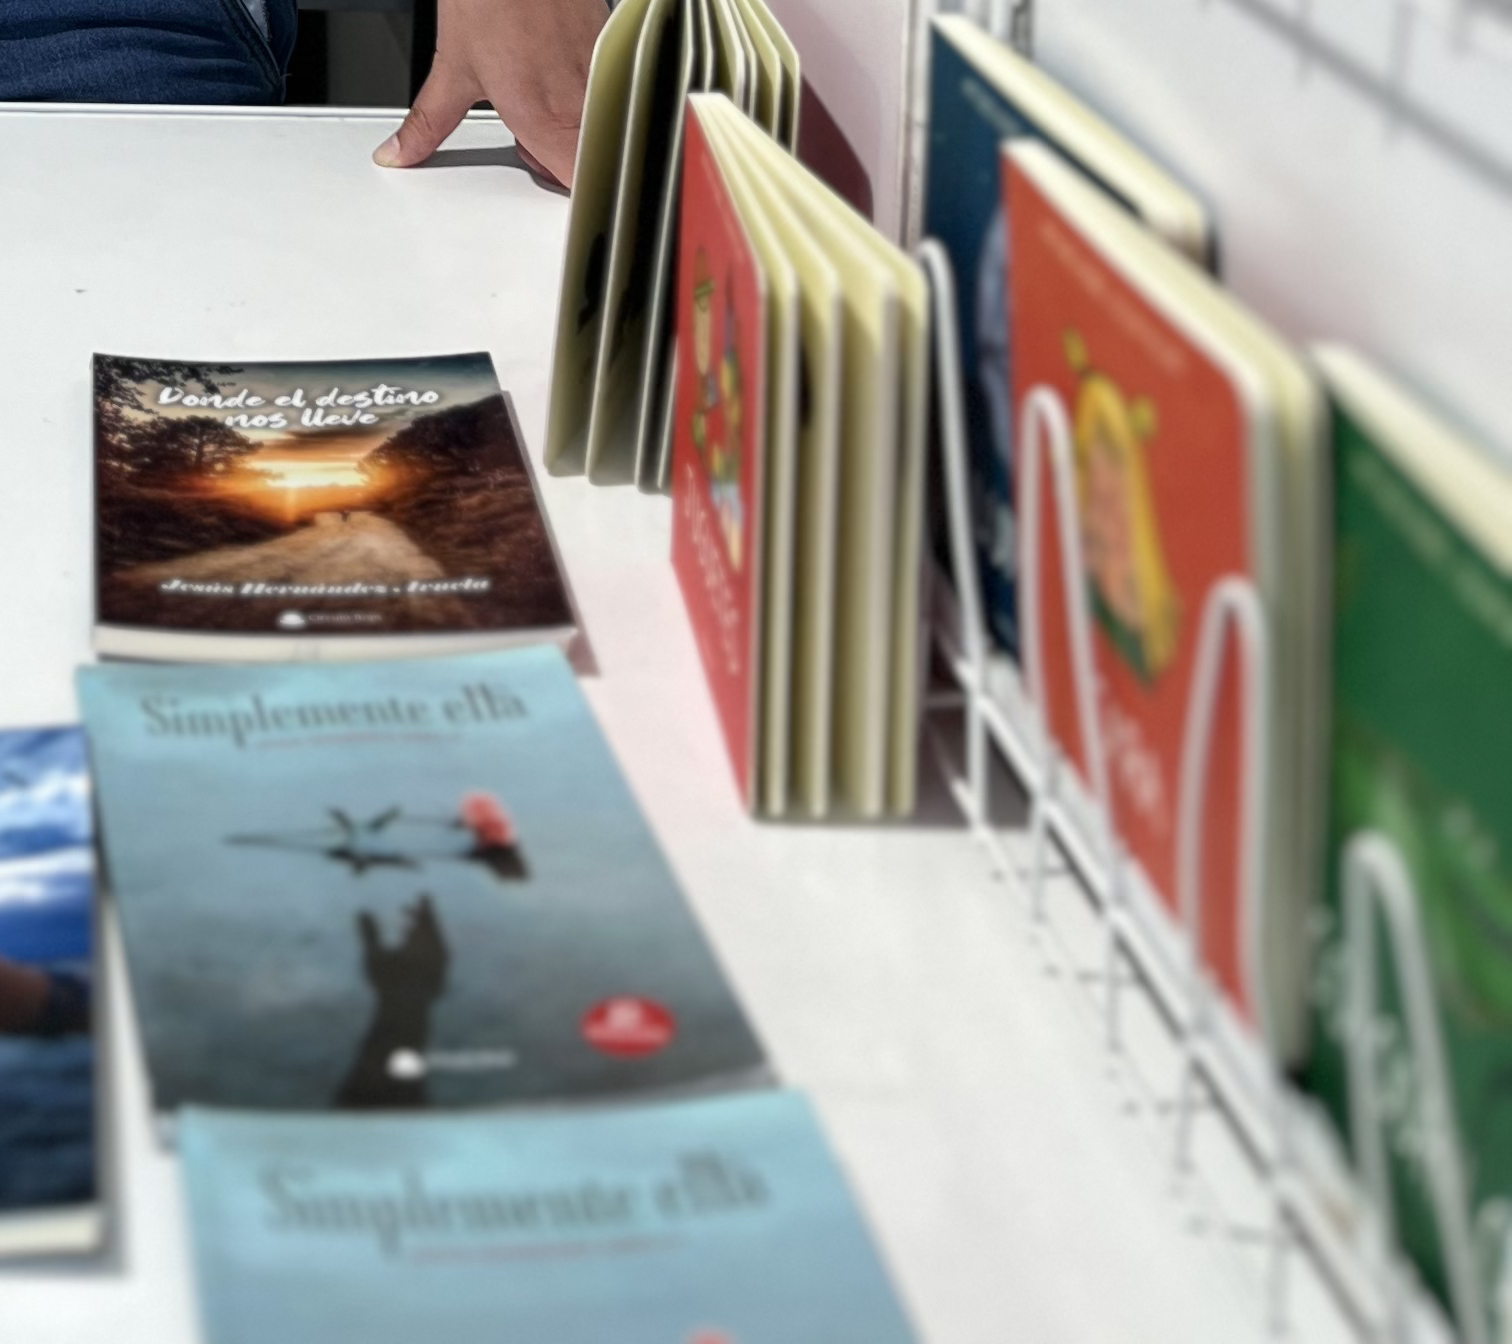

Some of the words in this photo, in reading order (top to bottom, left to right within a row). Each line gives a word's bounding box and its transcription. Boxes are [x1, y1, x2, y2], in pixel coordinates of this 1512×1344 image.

[157, 386, 266, 409] Donde
[274, 388, 306, 408] el
[315, 383, 440, 409] destino
[225, 412, 288, 429] nos
[301, 409, 380, 428] lleve
[140, 693, 430, 750] Simplemente
[441, 683, 530, 724] ella
[258, 1162, 635, 1259] Simplemente
[652, 1149, 773, 1217] ella
